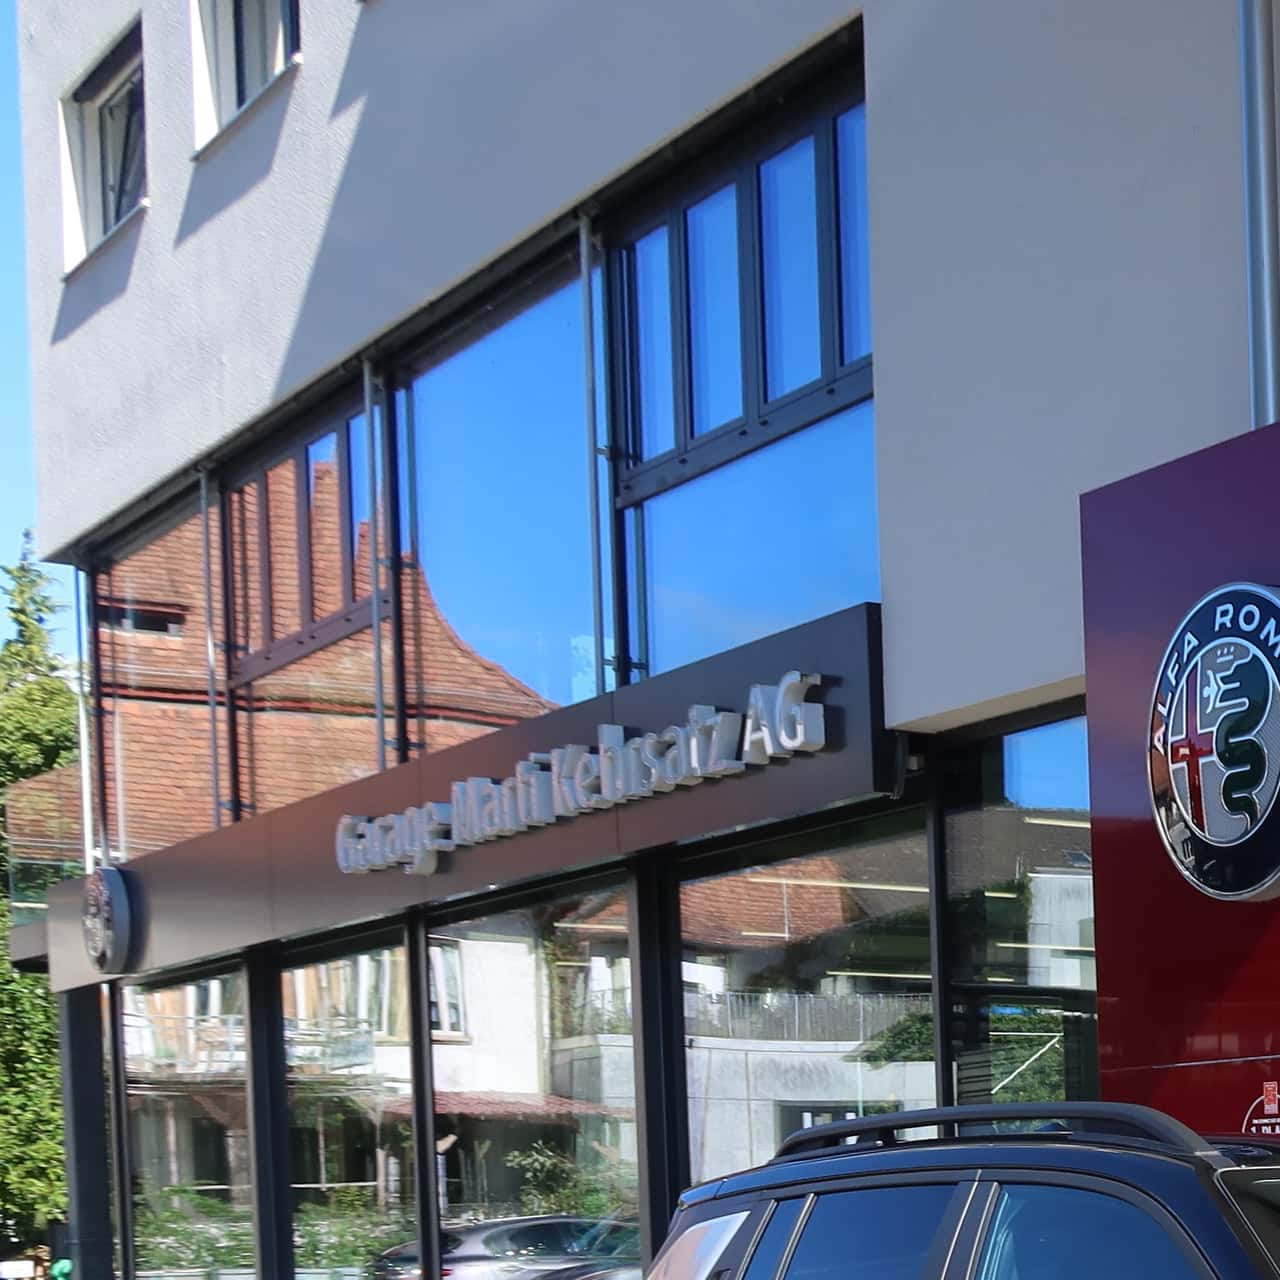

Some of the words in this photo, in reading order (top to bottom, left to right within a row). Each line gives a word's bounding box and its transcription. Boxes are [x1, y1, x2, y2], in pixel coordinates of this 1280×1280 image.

[336, 802, 455, 875] Garage
[451, 752, 556, 847] Marti
[550, 705, 746, 816] Kehrsatz
[743, 671, 826, 766] AG
[1153, 631, 1199, 754] ALFA
